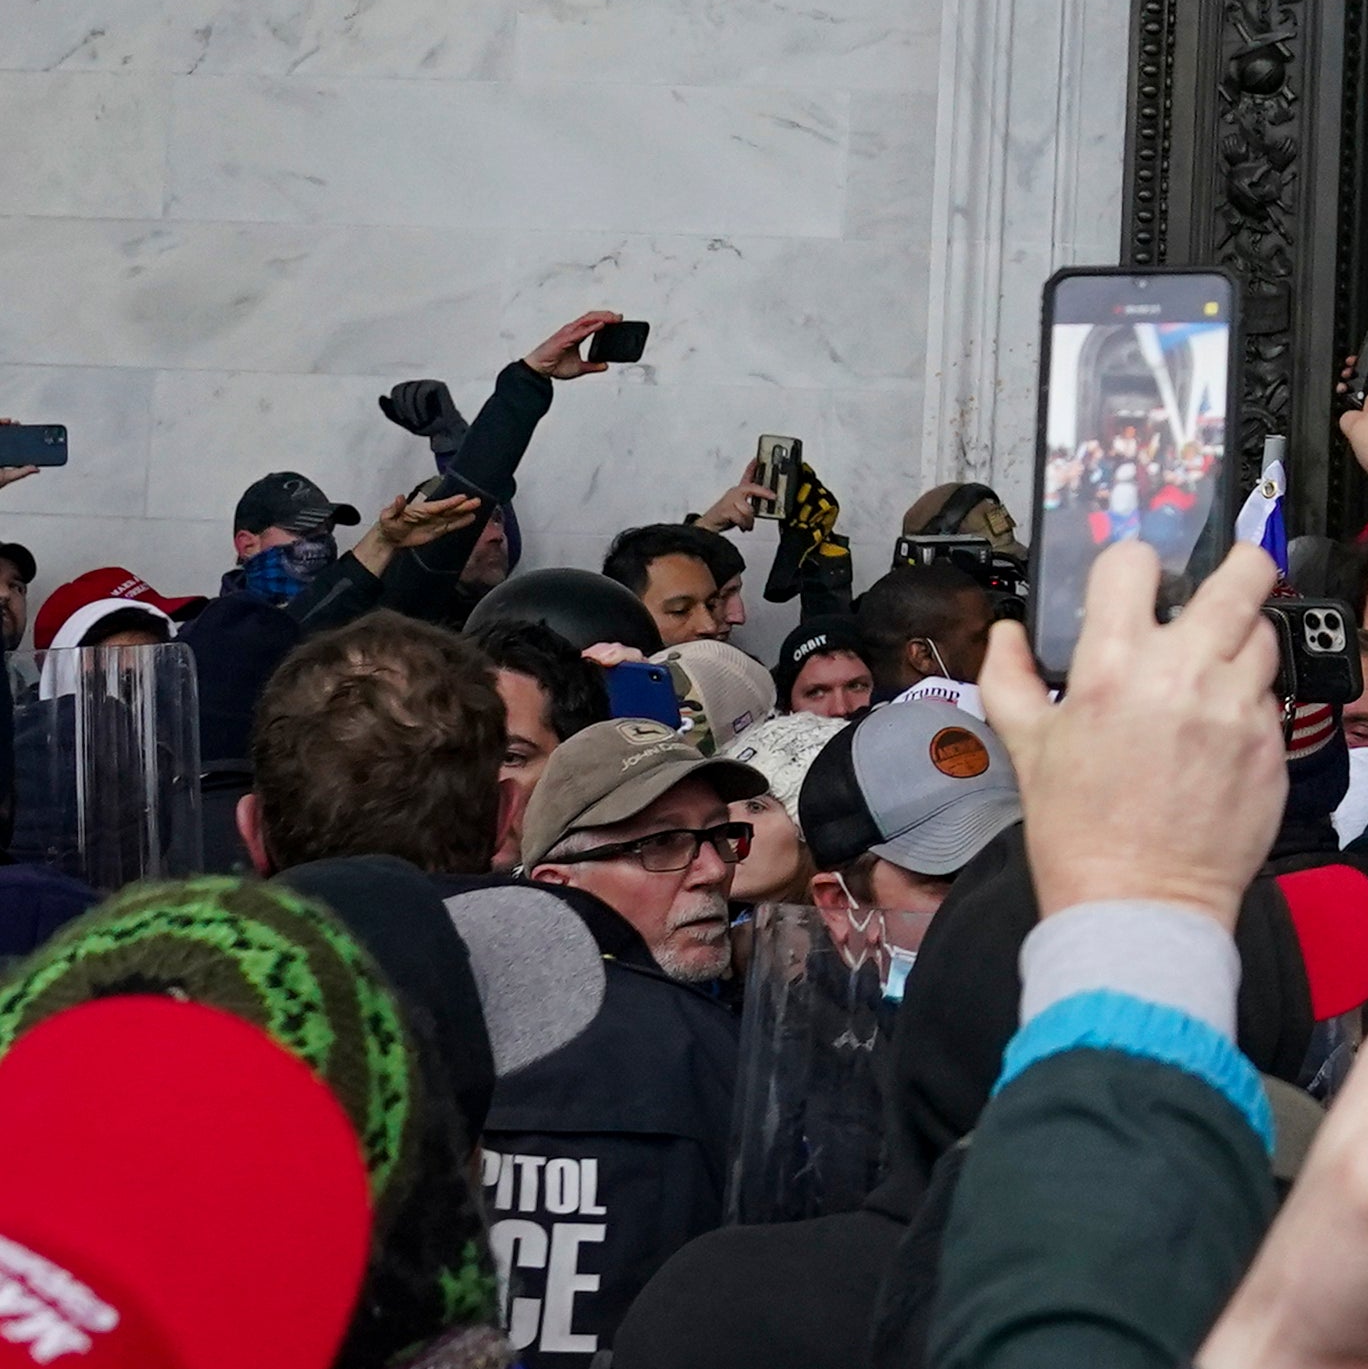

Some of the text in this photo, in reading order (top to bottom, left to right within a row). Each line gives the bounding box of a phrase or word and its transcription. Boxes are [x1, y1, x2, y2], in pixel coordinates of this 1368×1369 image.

[792, 634, 828, 662] ORBIT
[621, 743, 660, 772] JOHN
[480, 1147, 608, 1215] PITOL
[489, 1218, 608, 1353] CE
